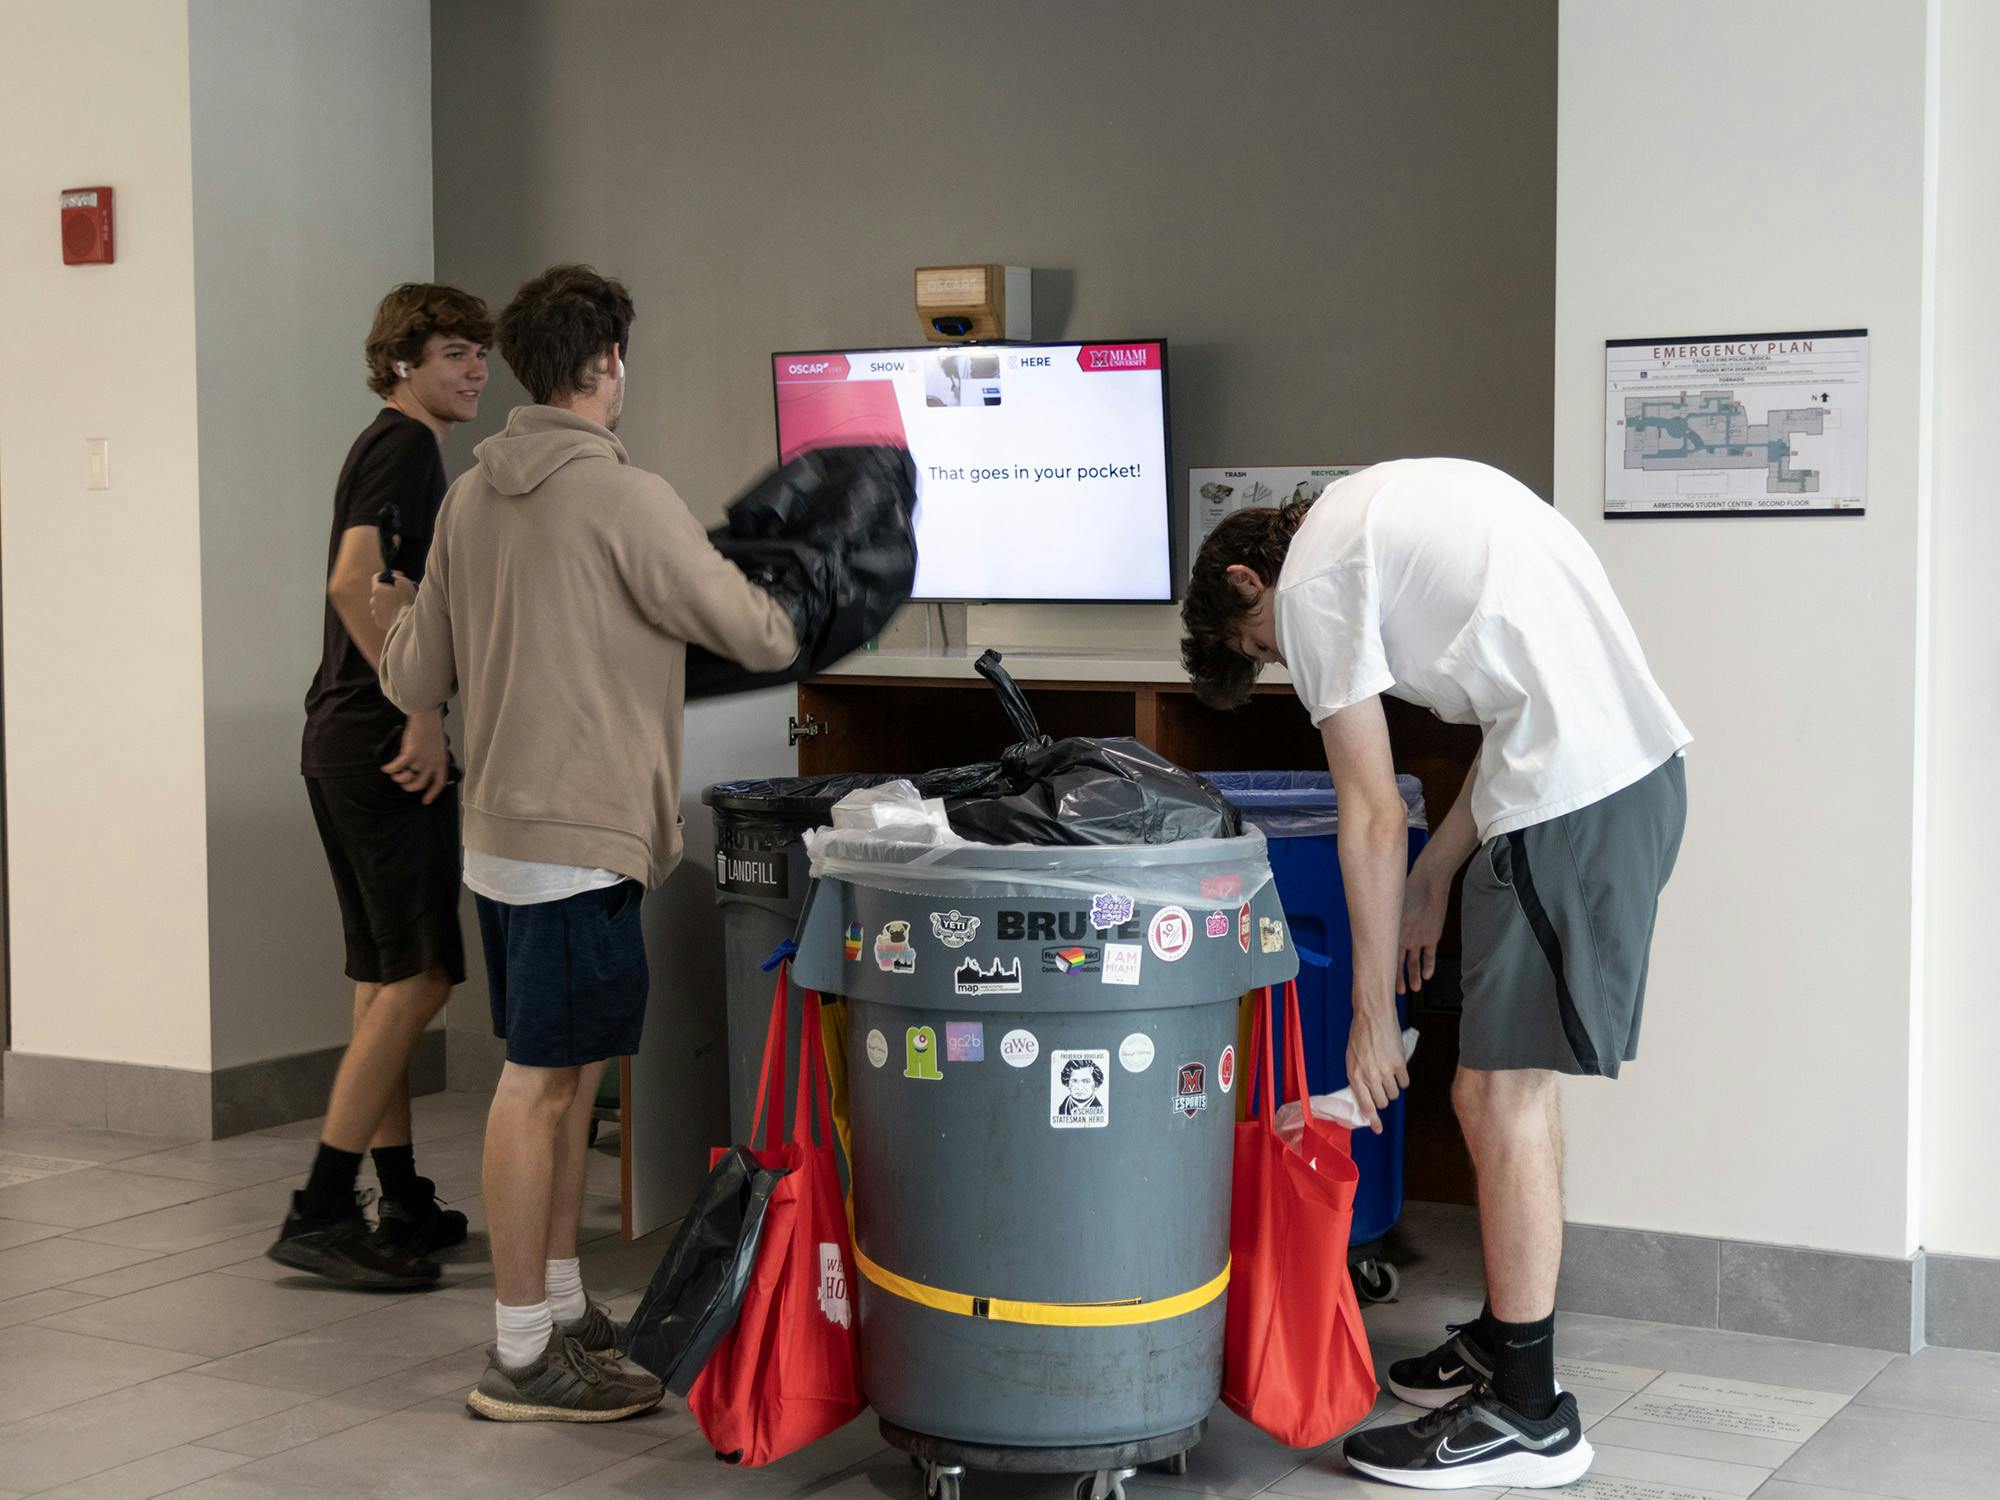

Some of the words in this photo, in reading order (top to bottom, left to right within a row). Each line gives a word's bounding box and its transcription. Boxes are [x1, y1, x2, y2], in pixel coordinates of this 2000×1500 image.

[1110, 349, 1147, 361] MIAMI
[1654, 343, 1758, 358] EMERGENCY
[1768, 341, 1813, 354] PLAN
[870, 362, 905, 372] SHOW
[1021, 356, 1051, 367] HERE
[788, 363, 824, 374] OSCAR
[929, 466, 965, 480] That
[970, 466, 1010, 483] goes
[1014, 464, 1029, 479] in
[1034, 466, 1072, 483] your
[1077, 463, 1141, 481] pocket!
[1311, 469, 1350, 477] RECYCLING
[728, 859, 777, 885] LANDFILL
[943, 920, 966, 930] YETI
[1115, 951, 1138, 963] AM
[1105, 964, 1137, 974] MIAMI
[958, 984, 979, 994] map
[949, 1033, 981, 1050] gc2b
[1181, 1069, 1203, 1094] M
[1175, 1095, 1206, 1111] ESPORTS
[1078, 1107, 1105, 1115] SCHOLAR
[1052, 1116, 1087, 1124] STATESMAN
[826, 1277, 848, 1300] HO
